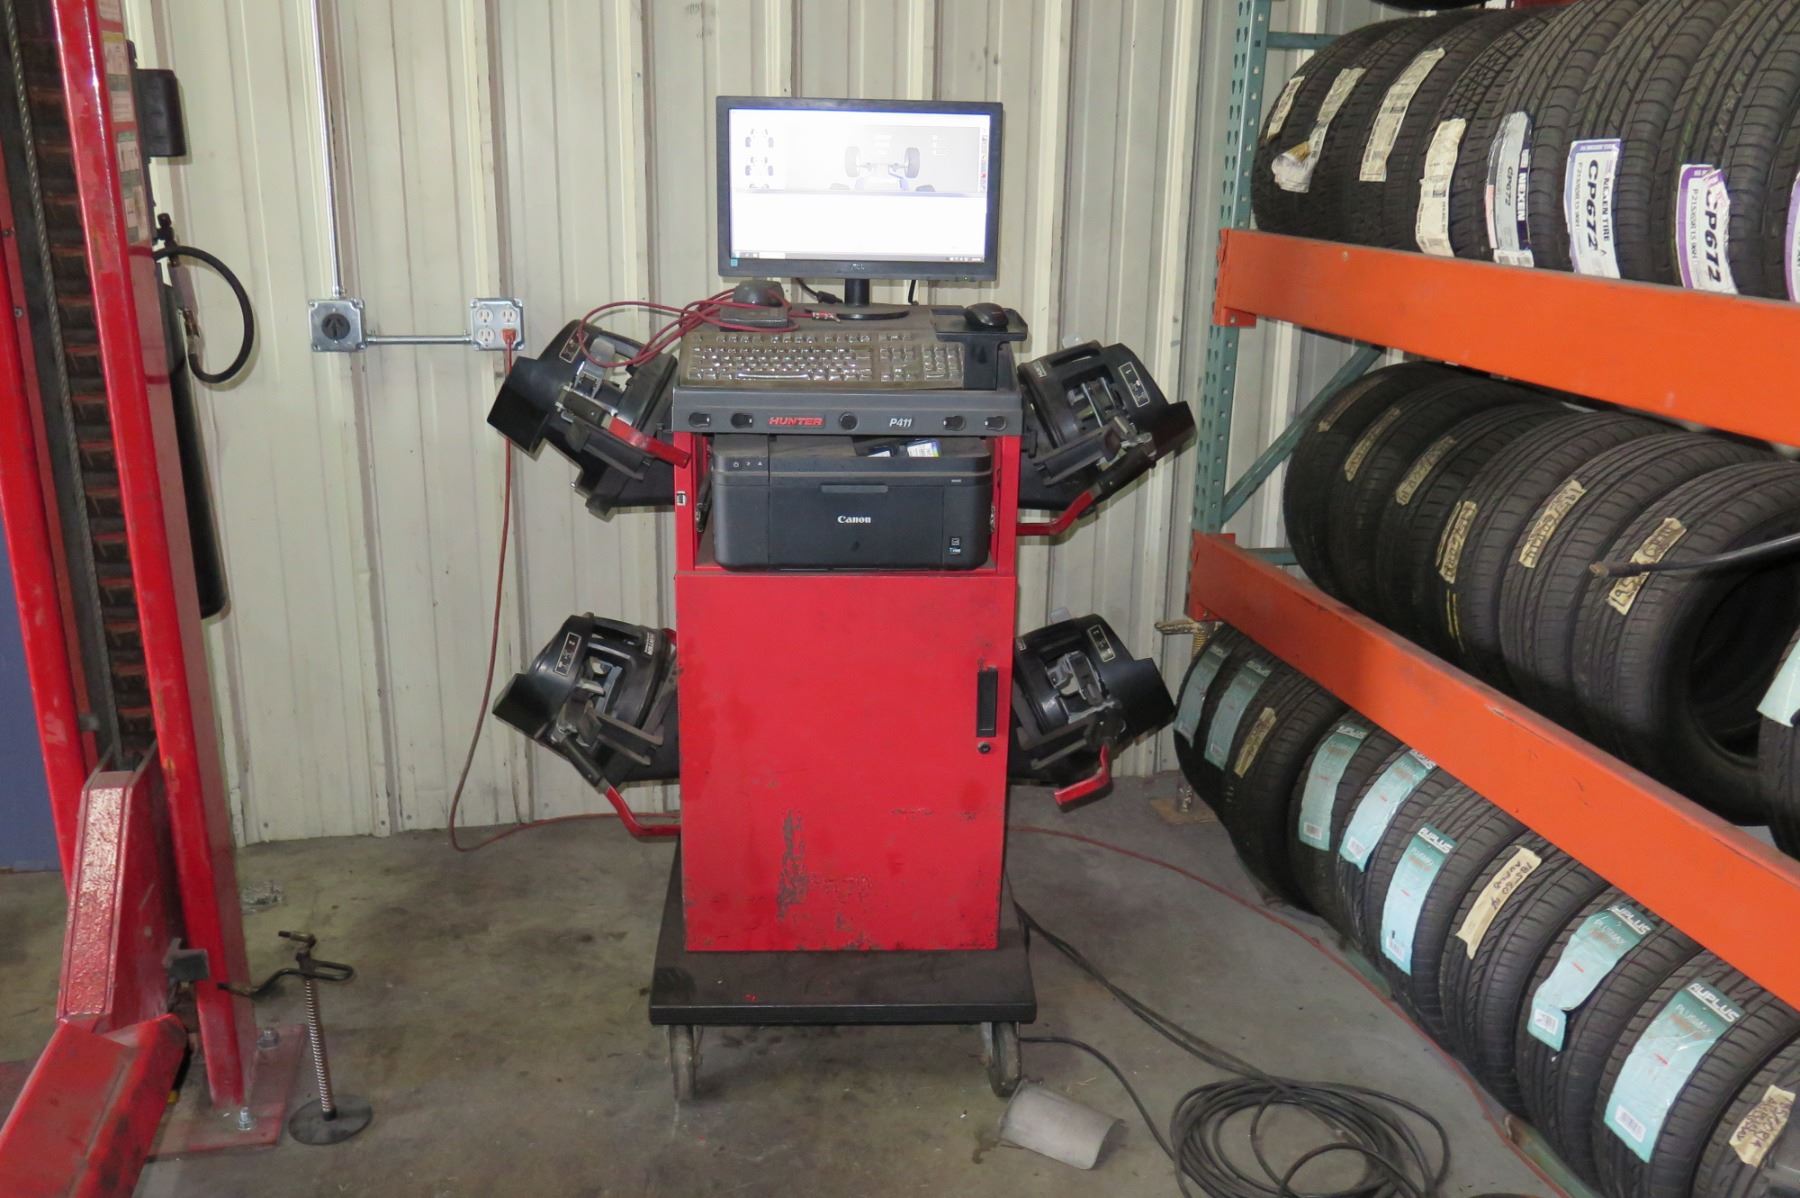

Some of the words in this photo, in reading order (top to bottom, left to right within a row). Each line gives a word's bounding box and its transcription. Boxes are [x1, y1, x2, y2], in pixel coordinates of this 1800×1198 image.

[1505, 166, 1513, 206] CP672
[1517, 172, 1527, 221] NEXEN
[1586, 159, 1599, 250] CP672
[1602, 217, 1610, 241] TIRE
[768, 416, 824, 426] HUNTER
[889, 418, 912, 428] P411
[837, 515, 872, 524] Canon
[1417, 827, 1453, 854] AUPLUS
[1687, 982, 1740, 1022] AUPLUS
